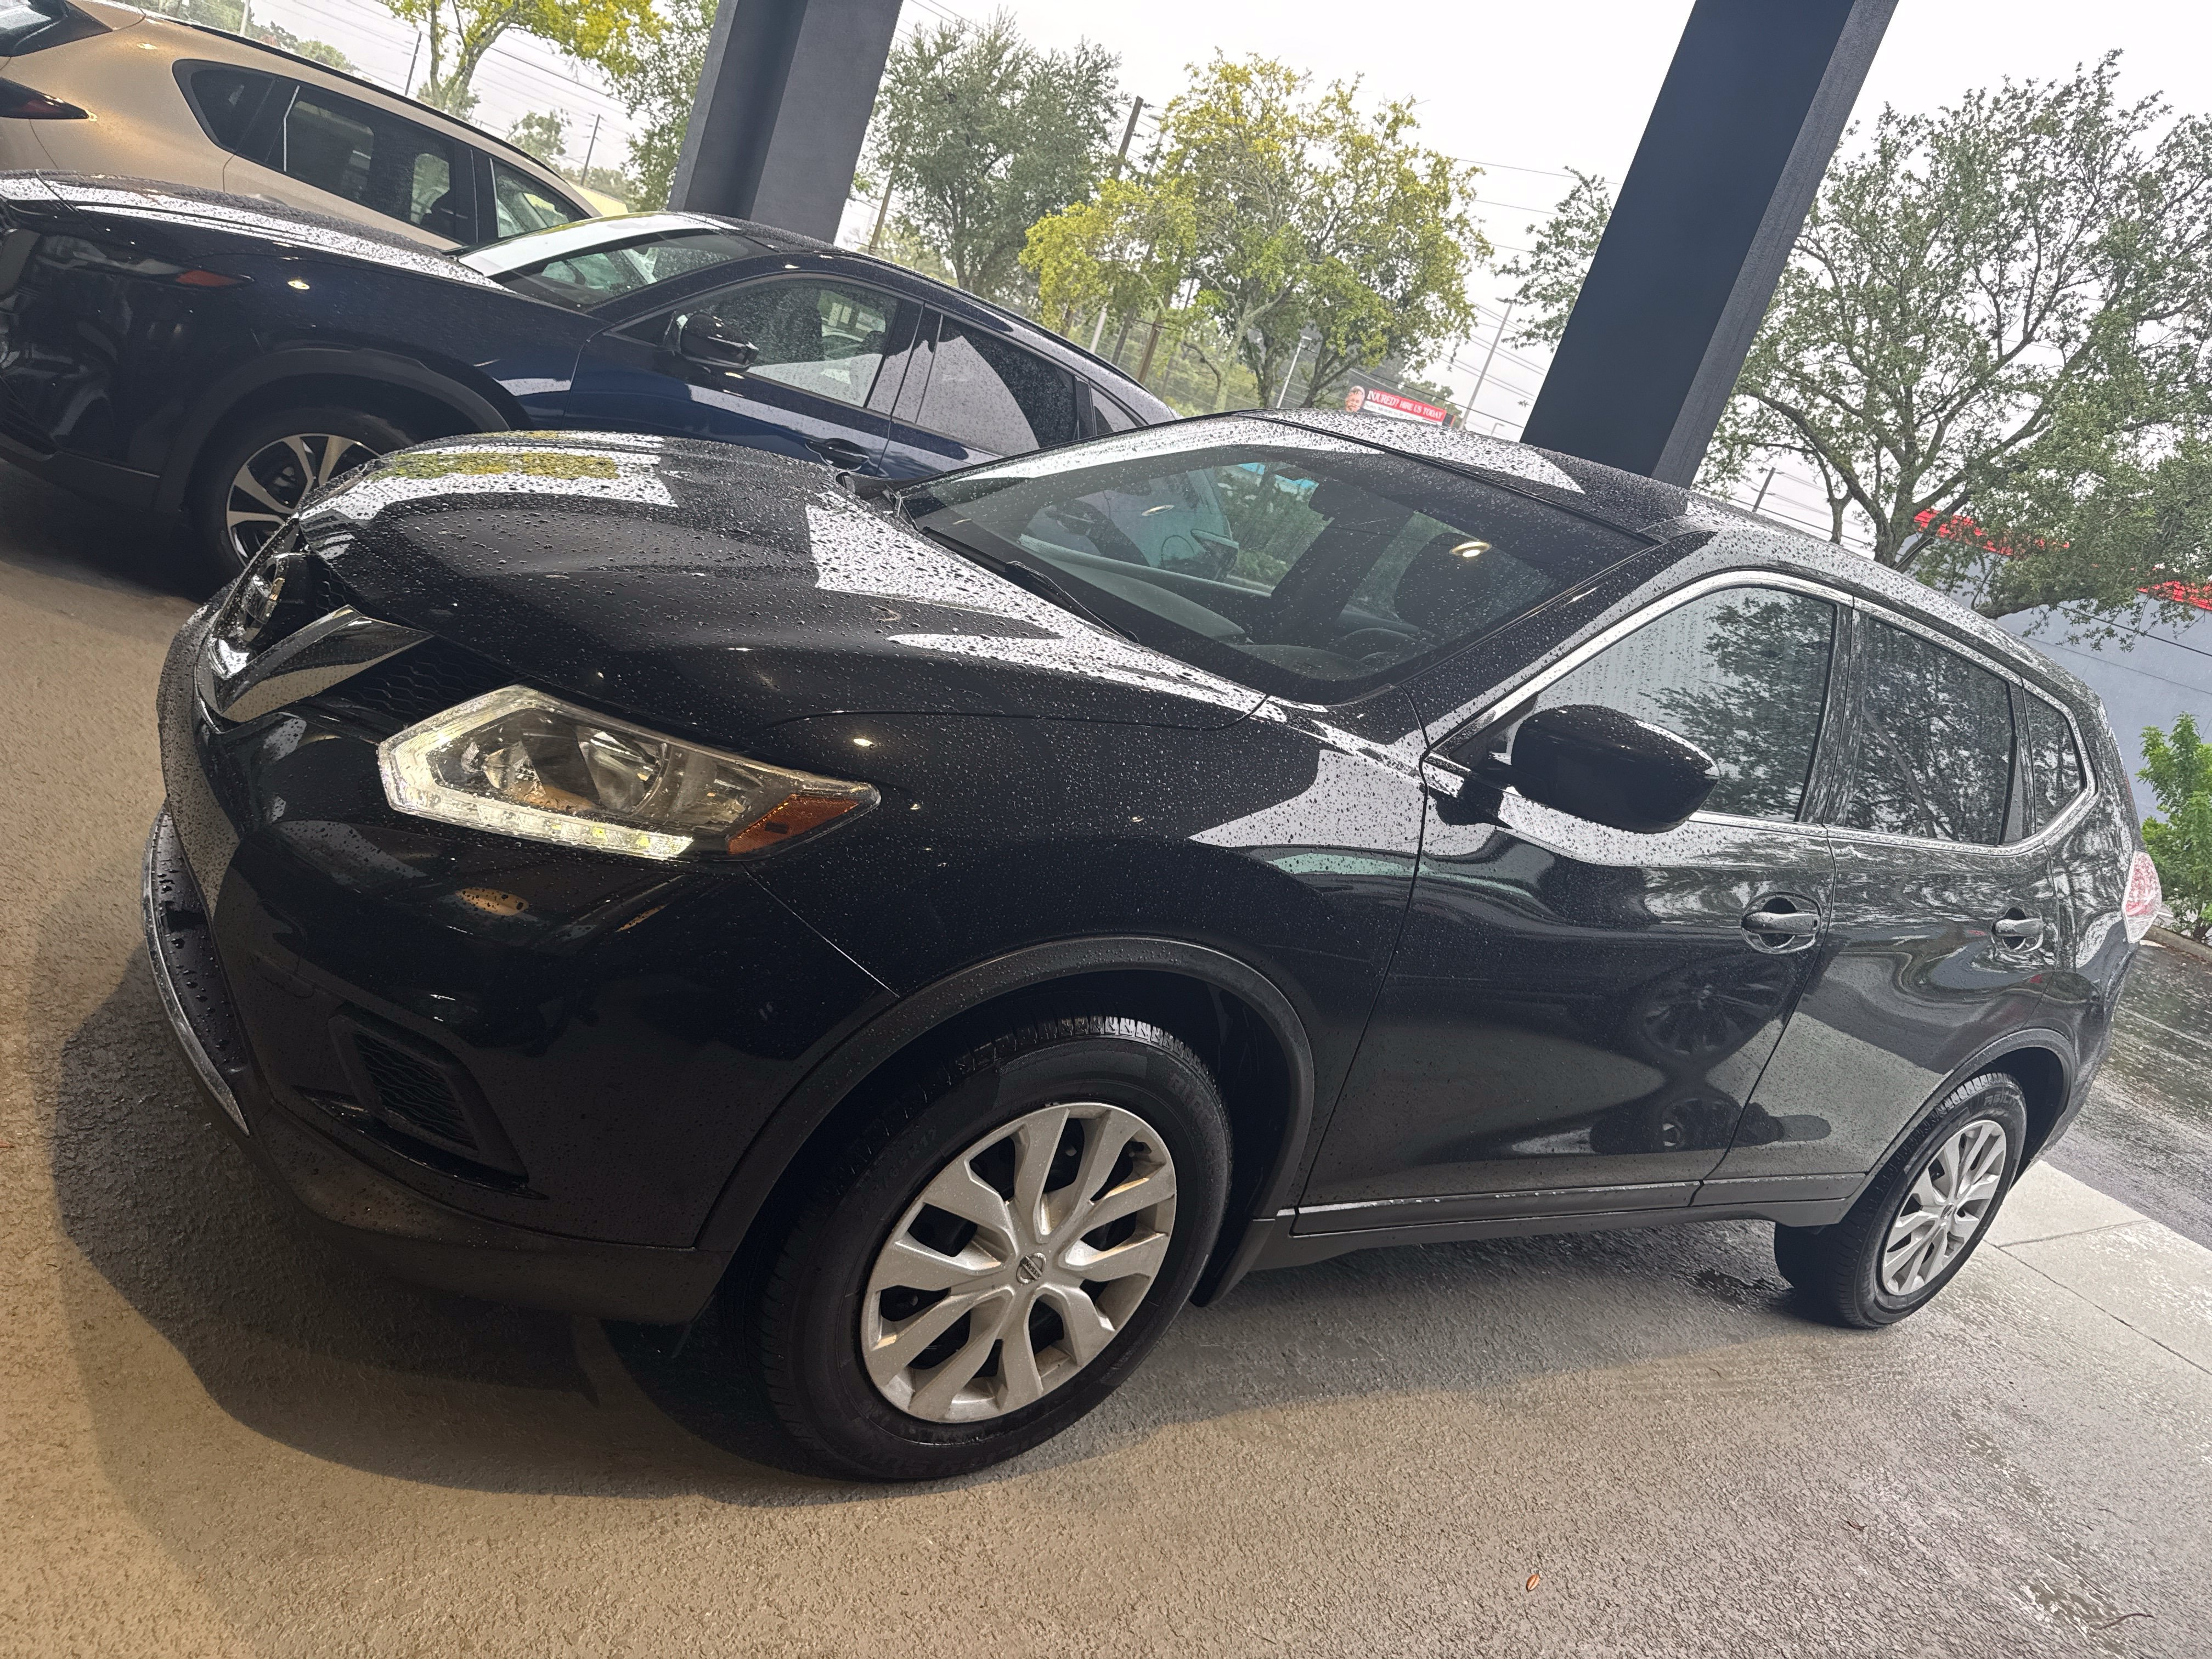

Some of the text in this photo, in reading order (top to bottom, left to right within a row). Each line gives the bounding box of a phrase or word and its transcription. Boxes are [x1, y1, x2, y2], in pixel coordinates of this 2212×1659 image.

[1367, 390, 1399, 407] INJURED?
[1400, 400, 1413, 411] HIRE
[1413, 404, 1423, 413] US
[1423, 408, 1442, 419] TODAY
[1024, 1261, 1041, 1279] NISSAN
